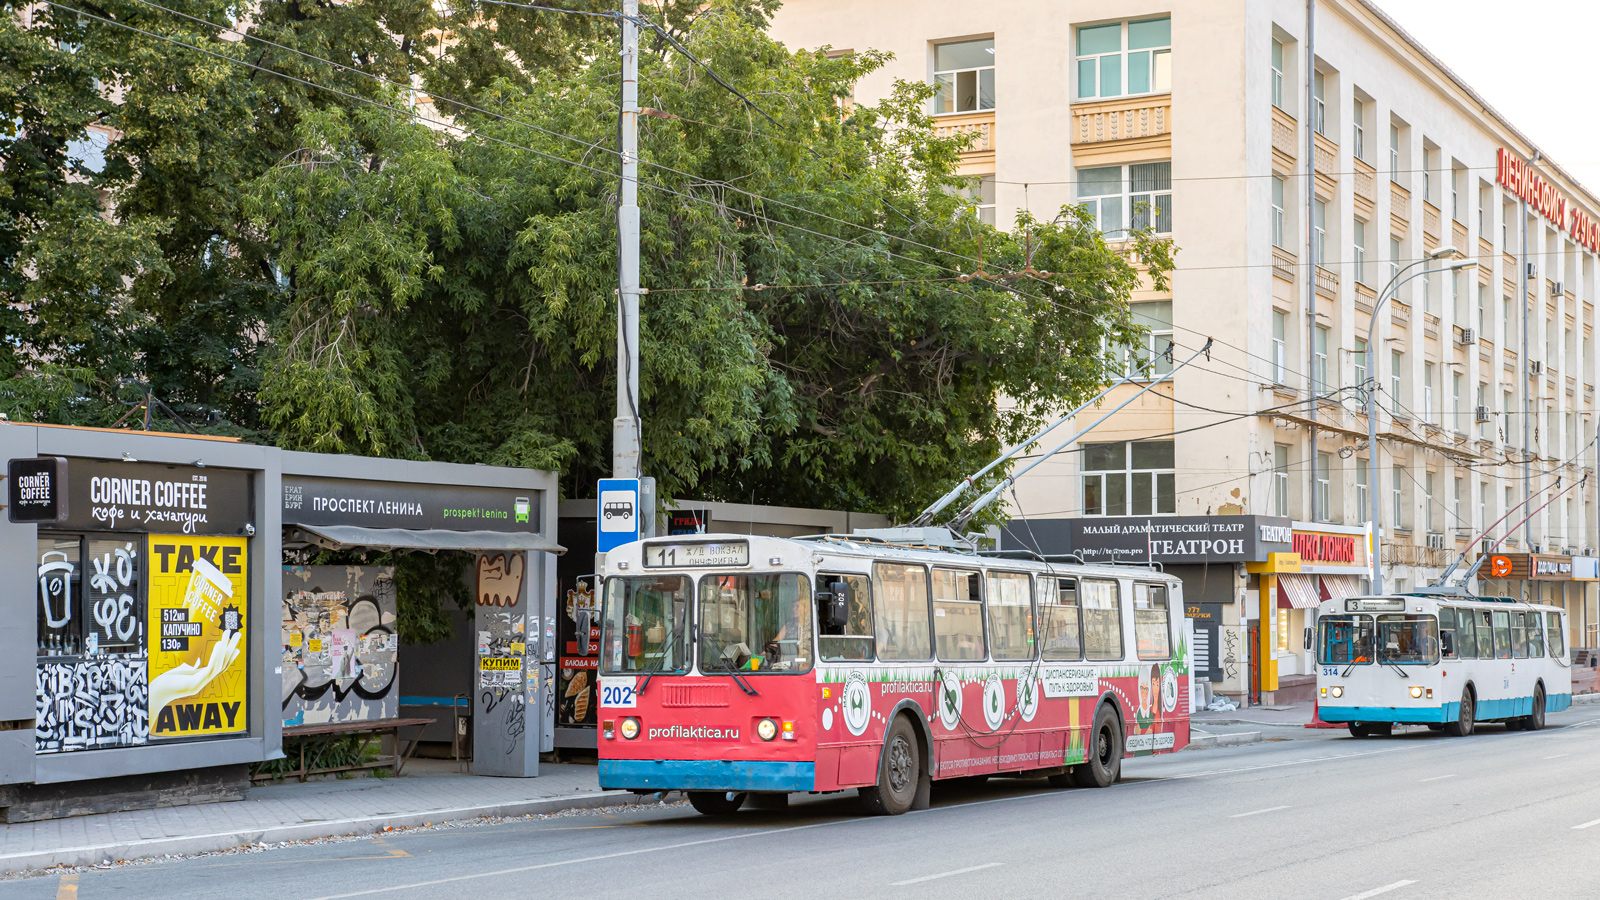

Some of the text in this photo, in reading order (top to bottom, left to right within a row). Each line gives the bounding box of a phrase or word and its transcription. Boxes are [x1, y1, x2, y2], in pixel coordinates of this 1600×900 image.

[19, 476, 50, 488] CORNER
[21, 487, 50, 500] COFFEE
[91, 477, 208, 509] CORNER COFFEE
[313, 497, 423, 516] ПРОСПЕКТ ЛЕНИНА
[443, 508, 508, 519] prospekt Lenina
[92, 504, 208, 534] кофе и хачапури
[674, 517, 702, 526] ГРИЛЬ
[1083, 521, 1245, 534] МАЛЫЙ ДРАМАТИЧЕСКИЙ ТЕАТР
[1260, 525, 1292, 543] ТЕАТРОН
[1150, 539, 1245, 555] ТЕАТРОН
[154, 544, 242, 574] TAKE
[658, 548, 676, 566] 11
[194, 575, 223, 607] CORNER
[187, 591, 217, 623] COFFEE
[1352, 602, 1358, 610] 3
[163, 623, 201, 636] КАПУЧИНО
[483, 659, 519, 667] КУПИМ
[564, 659, 588, 667] БЛЮДА
[1323, 668, 1338, 676] 314
[603, 687, 632, 705] 202
[881, 680, 933, 698] profilaktica.ru
[156, 701, 242, 733] AWAY
[649, 725, 739, 741] profilaktica.ru
